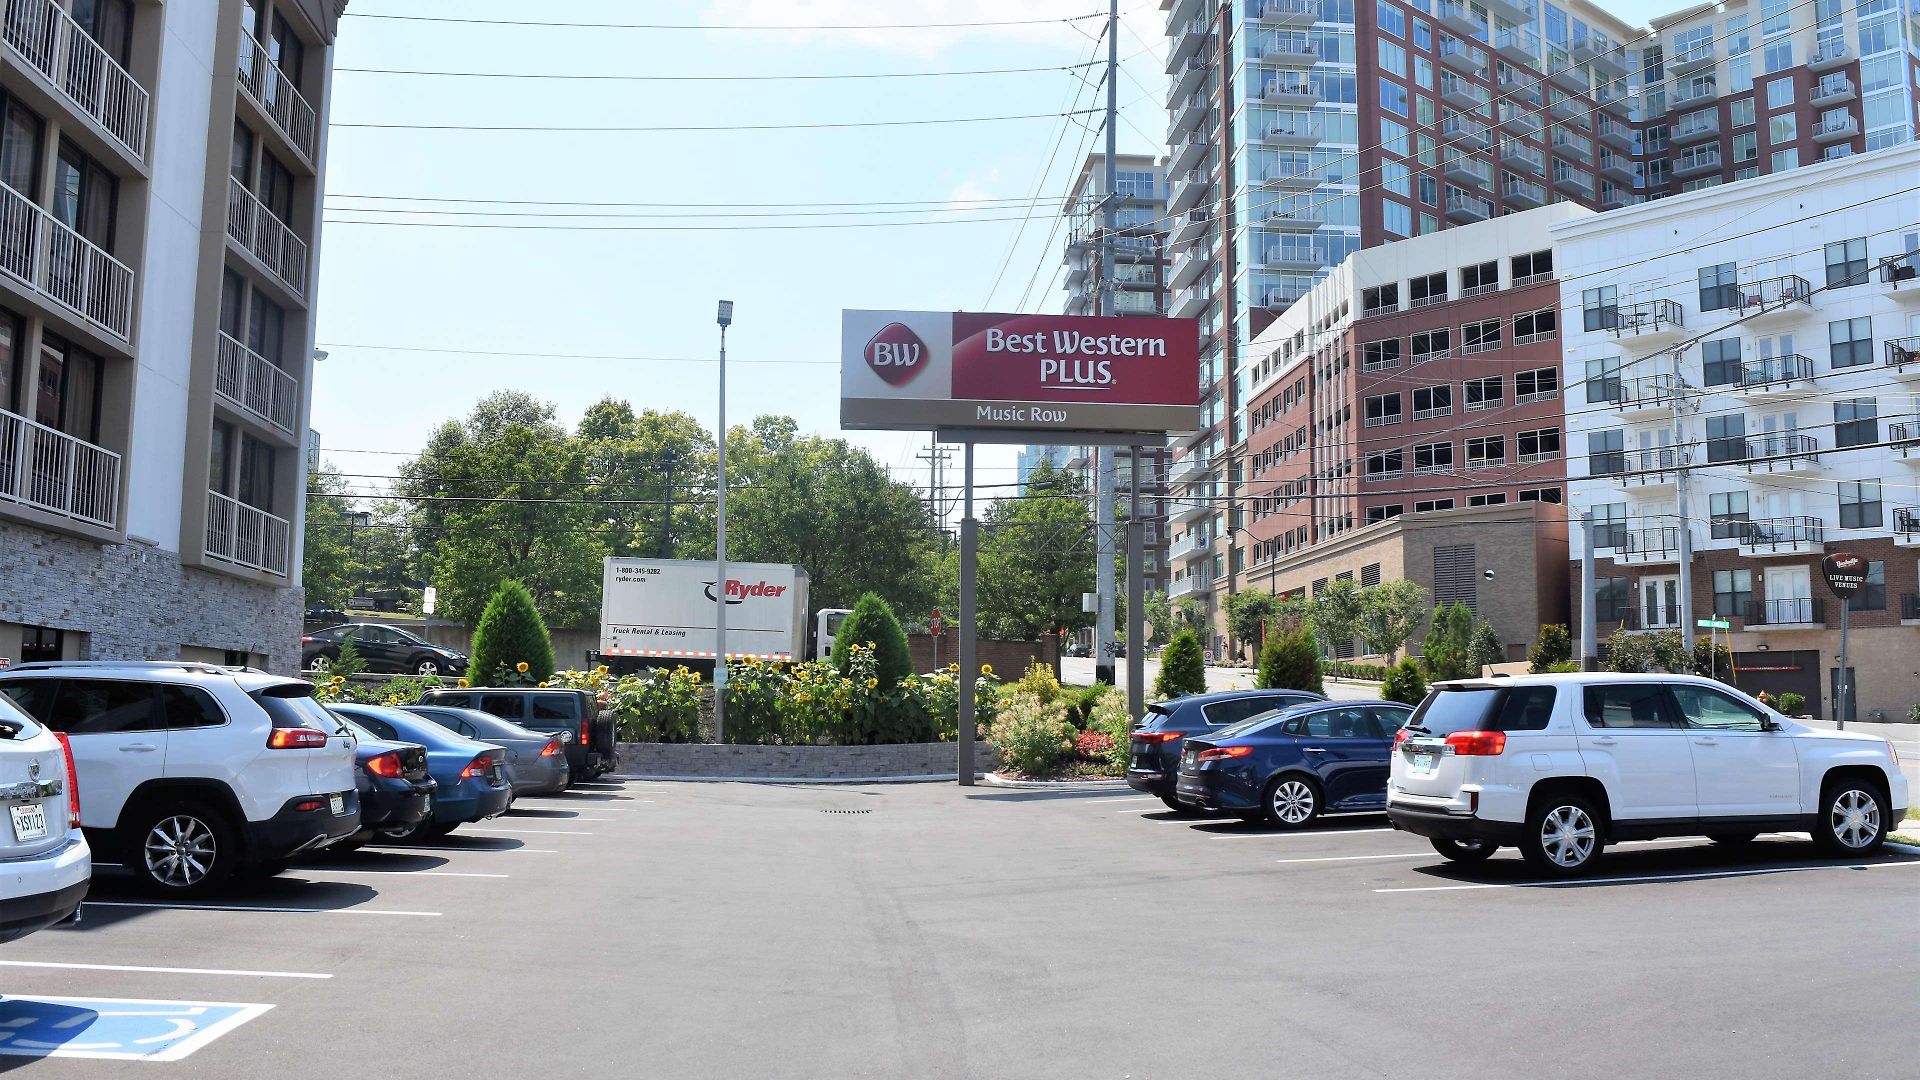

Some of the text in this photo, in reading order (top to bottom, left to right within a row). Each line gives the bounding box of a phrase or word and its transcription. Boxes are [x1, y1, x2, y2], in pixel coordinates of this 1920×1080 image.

[986, 328, 1166, 357] Best Western
[873, 341, 920, 367] BW
[976, 405, 1067, 423] Music Row
[615, 567, 661, 575] 1-800-345-9282
[724, 579, 786, 599] Ryder
[930, 617, 941, 628] STOP
[661, 629, 687, 638] Leasing
